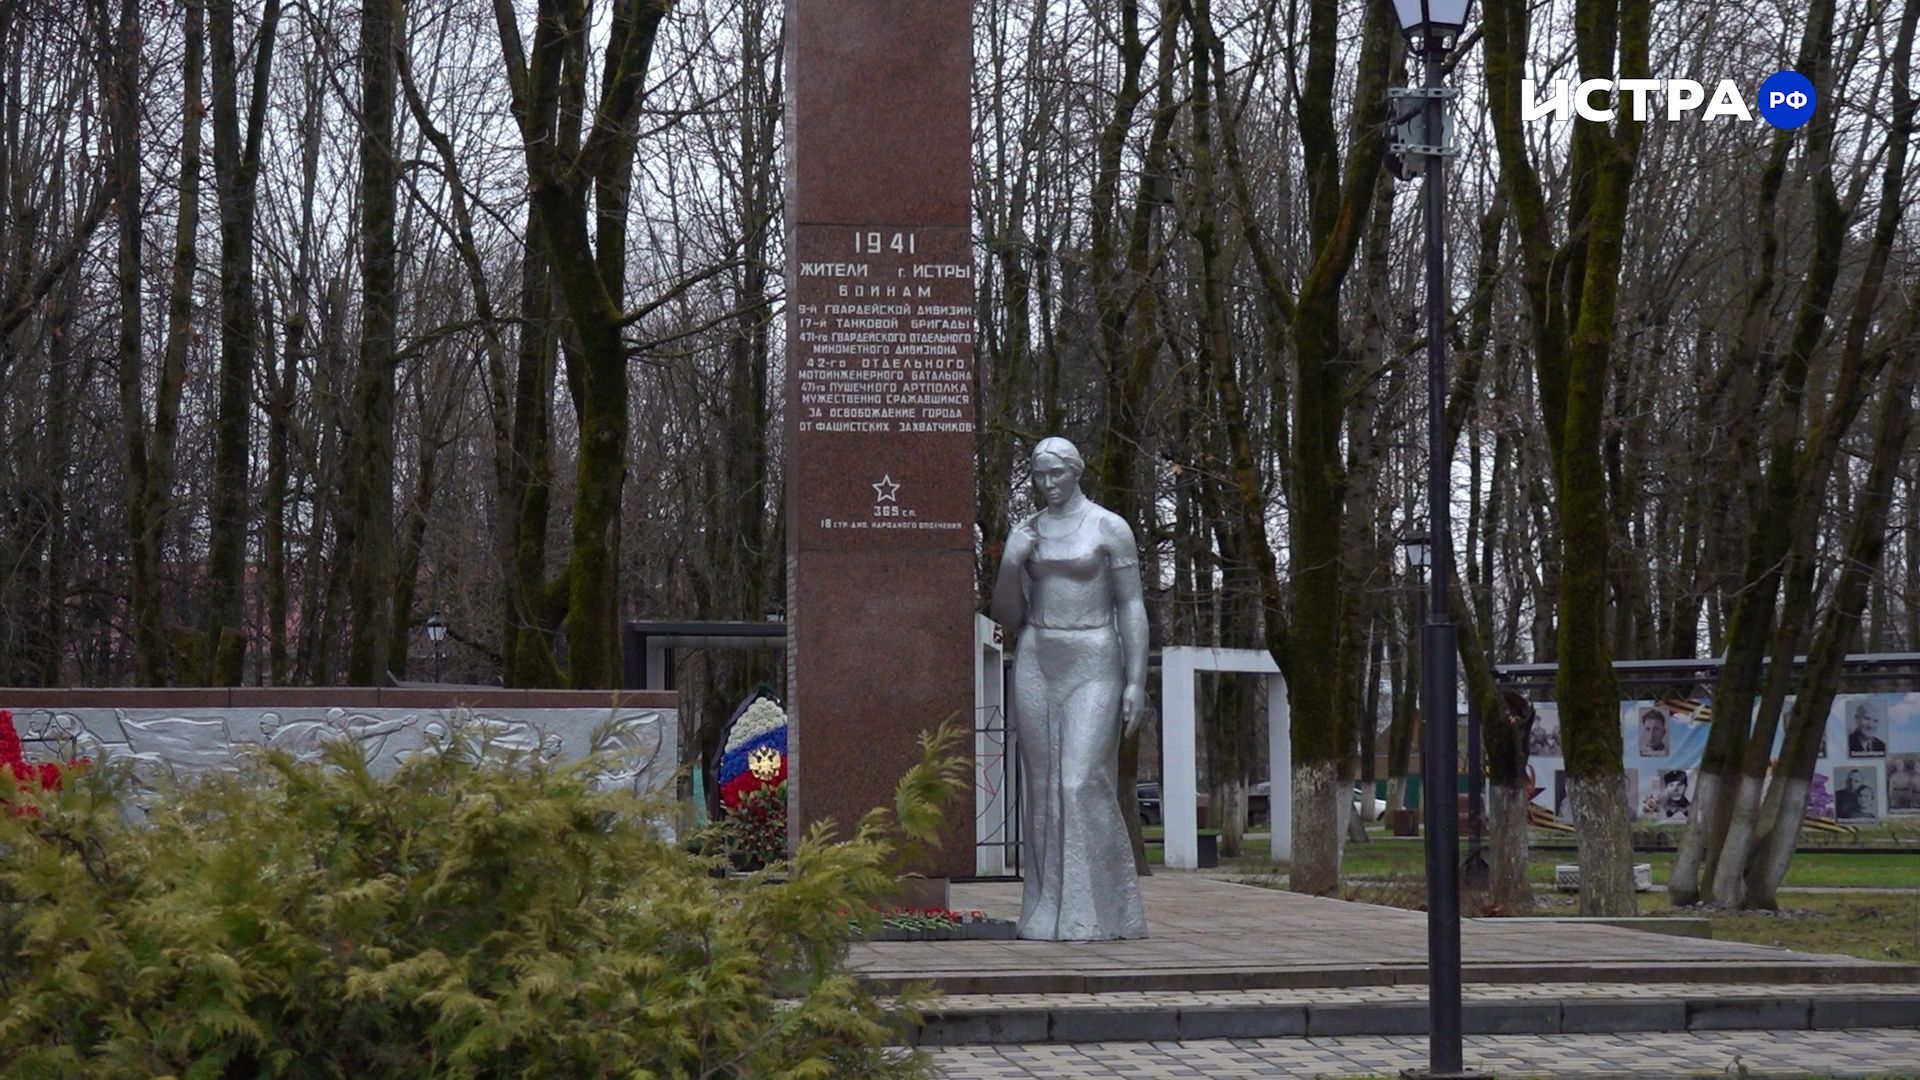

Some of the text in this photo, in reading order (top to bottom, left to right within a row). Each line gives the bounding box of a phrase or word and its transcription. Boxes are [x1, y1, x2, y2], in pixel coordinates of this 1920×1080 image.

[855, 231, 915, 254] 1941
[800, 262, 868, 277] ЖИТЕЛИ
[913, 264, 971, 279] ИСТРЫ
[824, 303, 911, 315] ГВАРДЕЙСКОЙ
[917, 305, 972, 316] ДИВИЗИИ
[836, 317, 898, 329] ТАНКОВОЙ
[911, 319, 970, 329] БРИГАДЫ
[831, 331, 906, 343] ГВАРДЕЙСКОГО
[909, 333, 971, 343] ОТДЕЛЬНОГО
[813, 344, 957, 355] МИНОМЕТНОГО ДИВИЗИОНА
[806, 358, 965, 369] 42-го ОТДЕЛЬНОГО
[798, 370, 972, 381] МОТОИНЖЕНЕРНОГО БАТАЛЬОНА
[829, 382, 897, 392] ПУШЕЧНОГО
[902, 383, 968, 393] АРТПОЛКА
[802, 394, 970, 405] МУЖЕСТВЕННО СРАЖАВШИМСЯ
[809, 407, 962, 418] ЗА ОСВОБОЖДЕНИЕ ГОРОДА
[800, 421, 972, 432] ОТ ФАШИСТСКИХ ЗАХВАТЧИКОВ
[820, 519, 832, 528] 18
